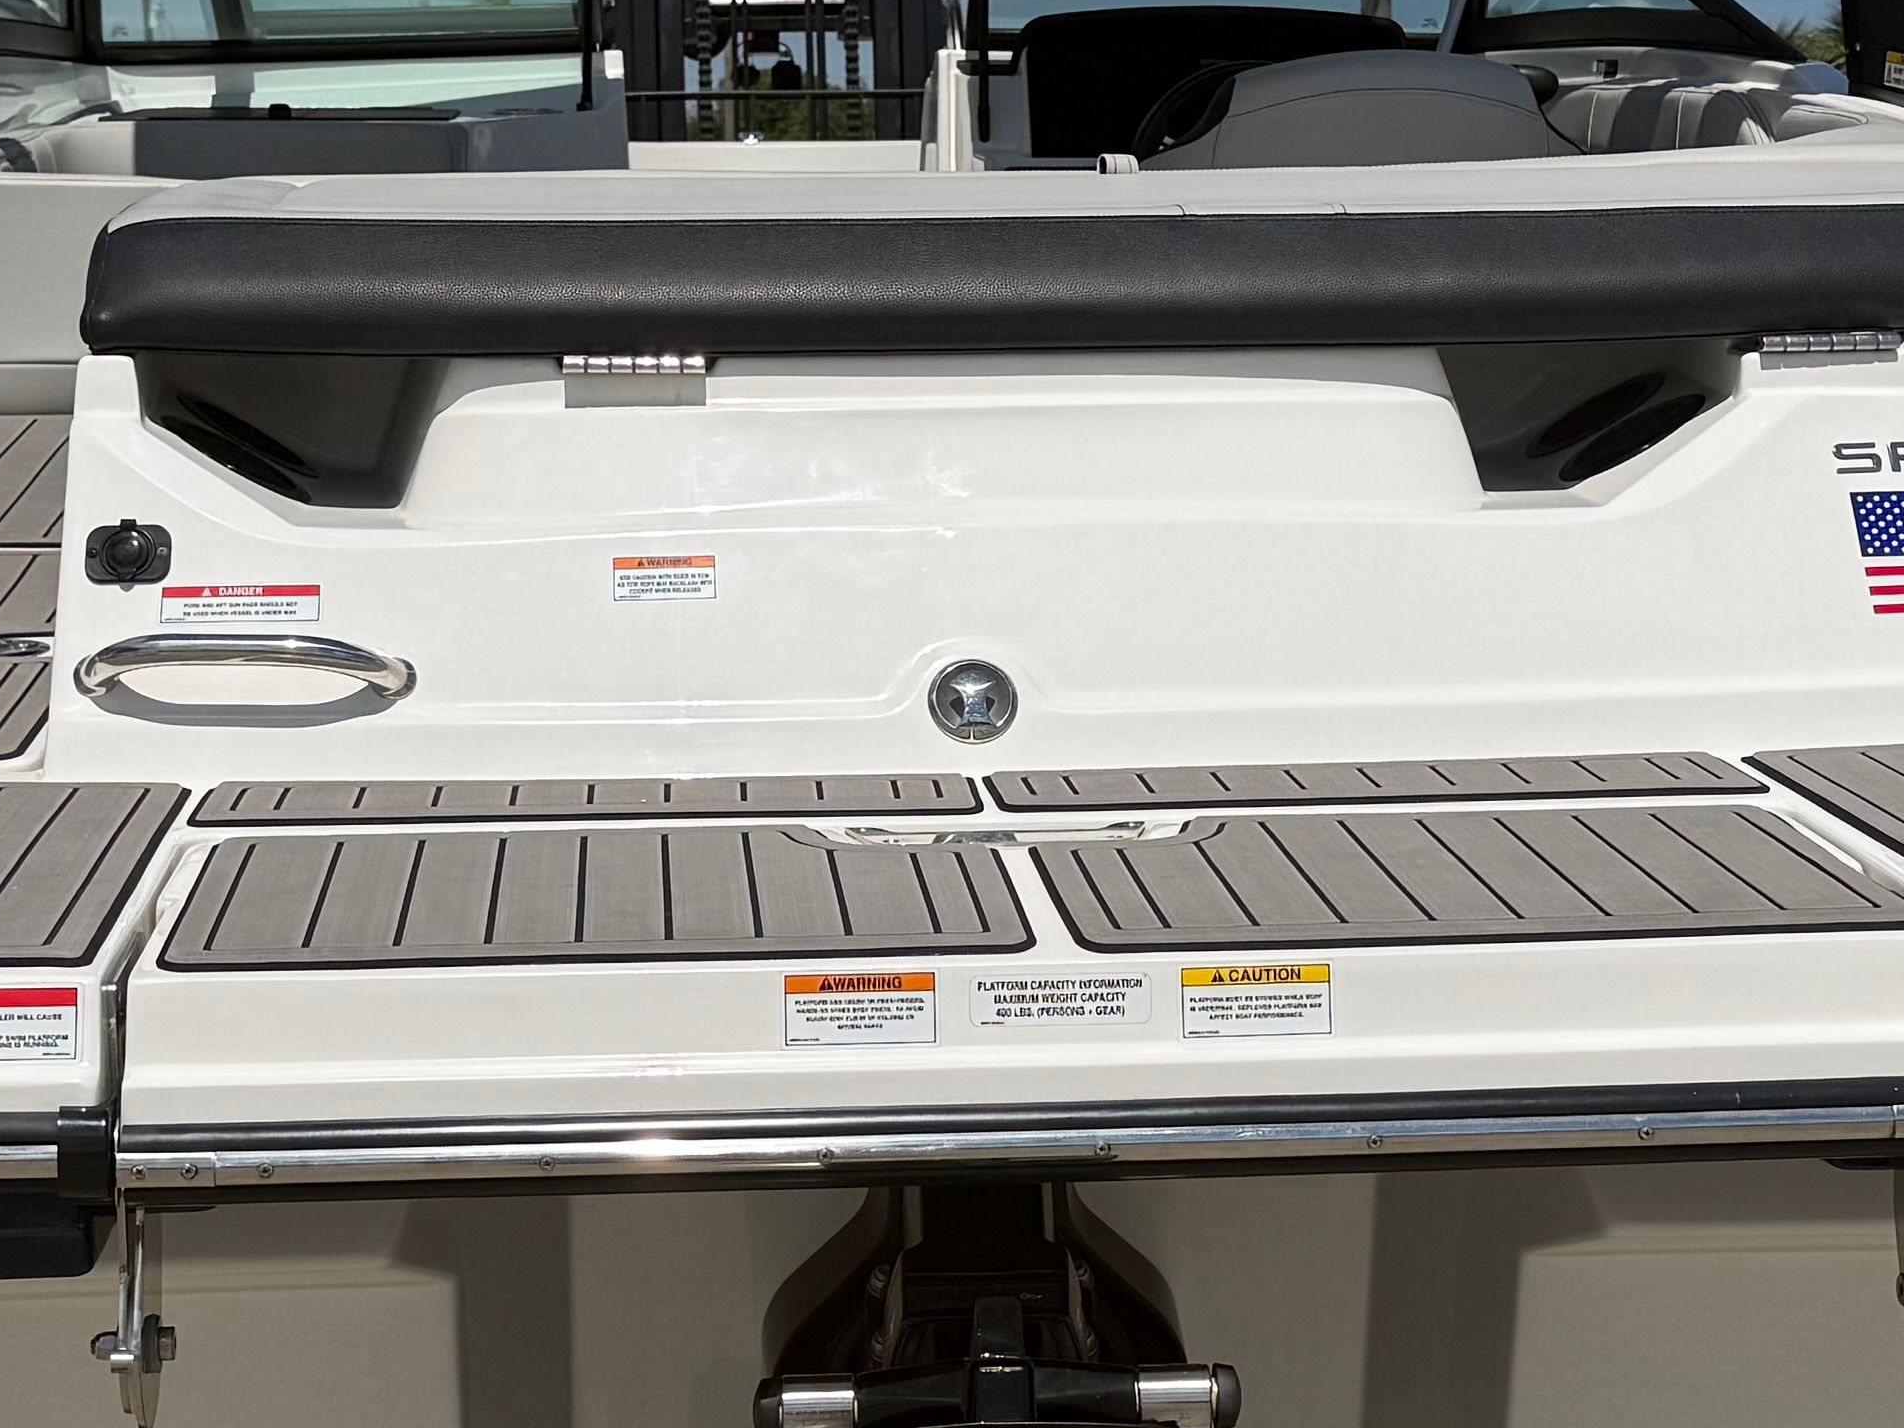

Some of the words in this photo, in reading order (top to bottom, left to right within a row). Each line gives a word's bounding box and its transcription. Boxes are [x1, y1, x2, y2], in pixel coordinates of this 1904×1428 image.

[218, 587, 265, 596] DANGER
[1228, 968, 1301, 982] CAUTION
[833, 976, 902, 990] WARNING
[1031, 980, 1077, 990] CAPACITY
[1081, 992, 1126, 1002] CAPACITY
